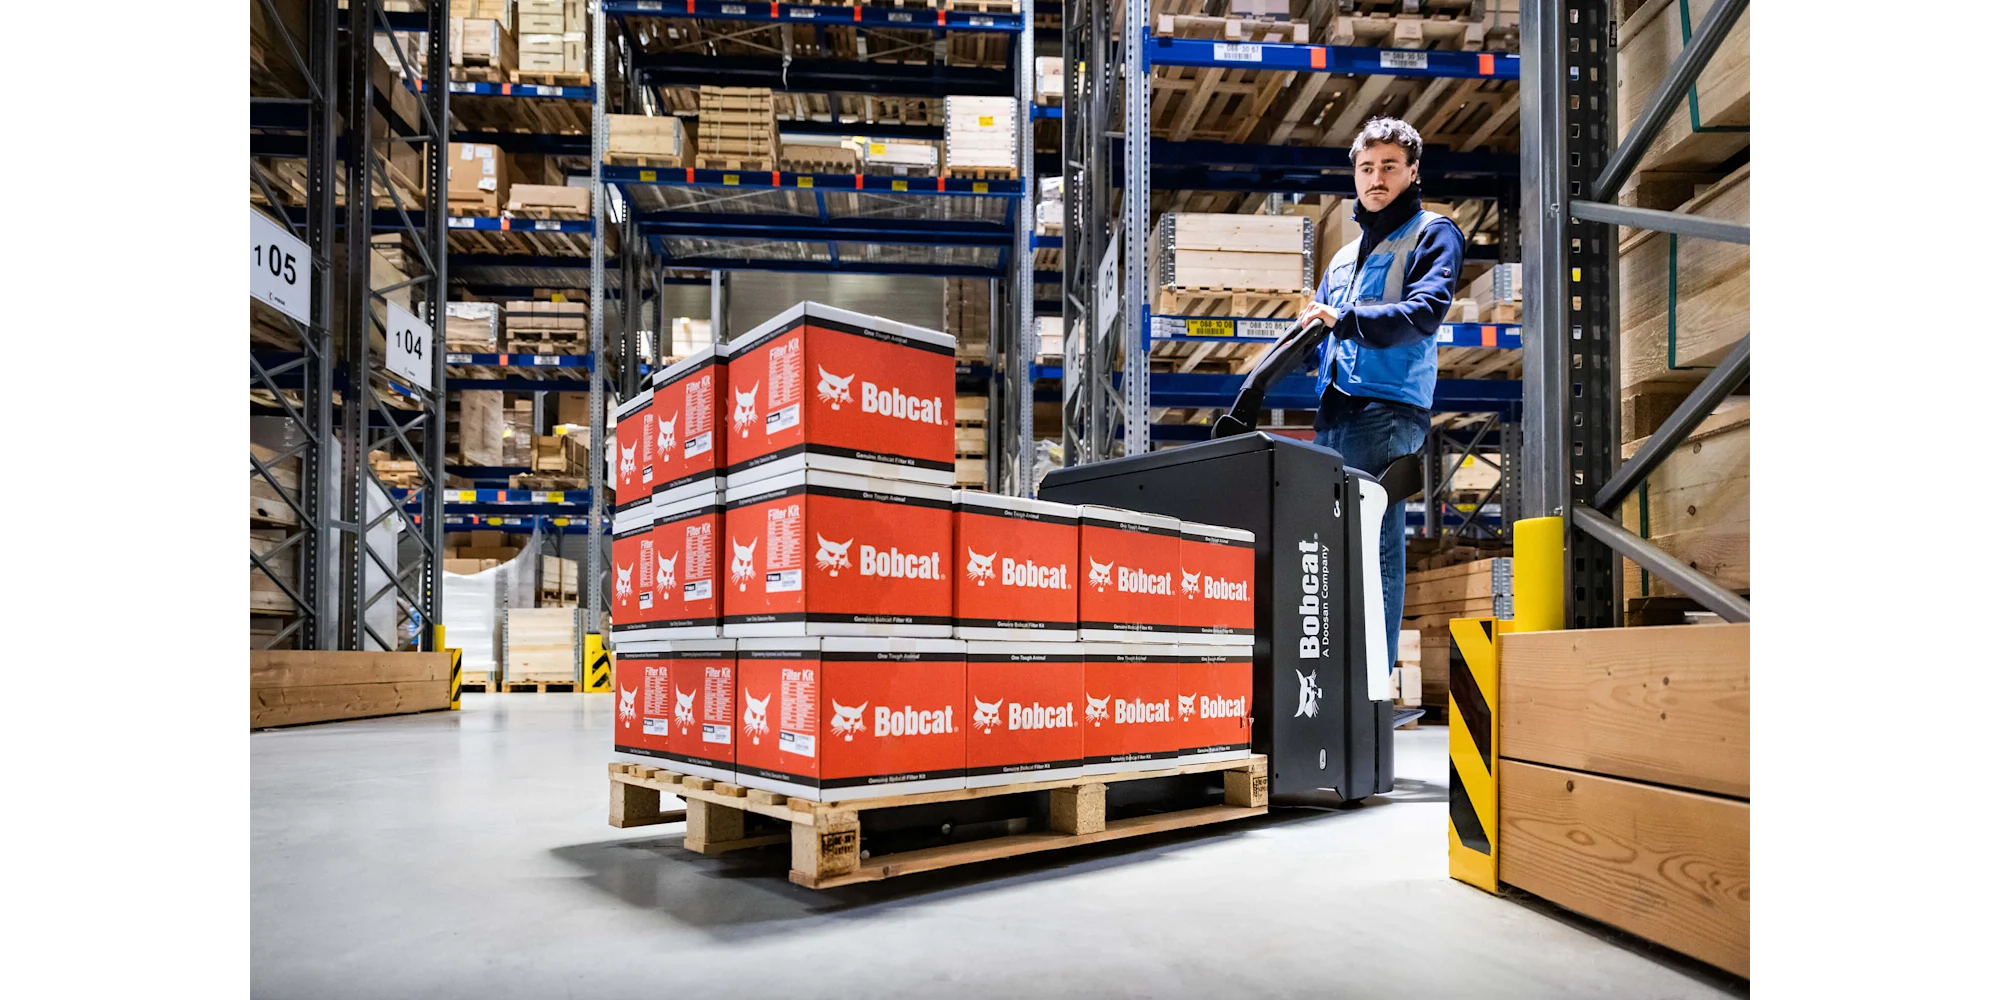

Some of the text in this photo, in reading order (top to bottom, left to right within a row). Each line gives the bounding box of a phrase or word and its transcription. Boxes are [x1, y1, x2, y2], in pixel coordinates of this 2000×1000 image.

[268, 244, 297, 286] 05
[405, 329, 423, 360] 04
[769, 344, 788, 361] Filter
[788, 337, 799, 352] Kit
[686, 380, 701, 393] Filter
[701, 375, 711, 386] Kit
[862, 381, 943, 425] Bobcat
[768, 504, 799, 521] Filter Kit
[686, 522, 711, 537] Filter Kit
[860, 545, 940, 580] Bobcat
[1002, 557, 1067, 589] Bobcat
[1321, 545, 1329, 599] Company
[1118, 566, 1171, 595] Bobcat
[1204, 576, 1247, 601] Bobcat
[1299, 540, 1320, 659] Bobcat
[1322, 648, 1329, 657] A
[645, 666, 667, 676] Filter Kit
[705, 667, 731, 677] Filter Kit
[782, 668, 814, 681] Filter Kit
[1008, 702, 1073, 730] Bobcat
[1115, 698, 1170, 724] Bobcat
[1200, 695, 1245, 718] Bobcat
[874, 705, 953, 737] Bobcat
